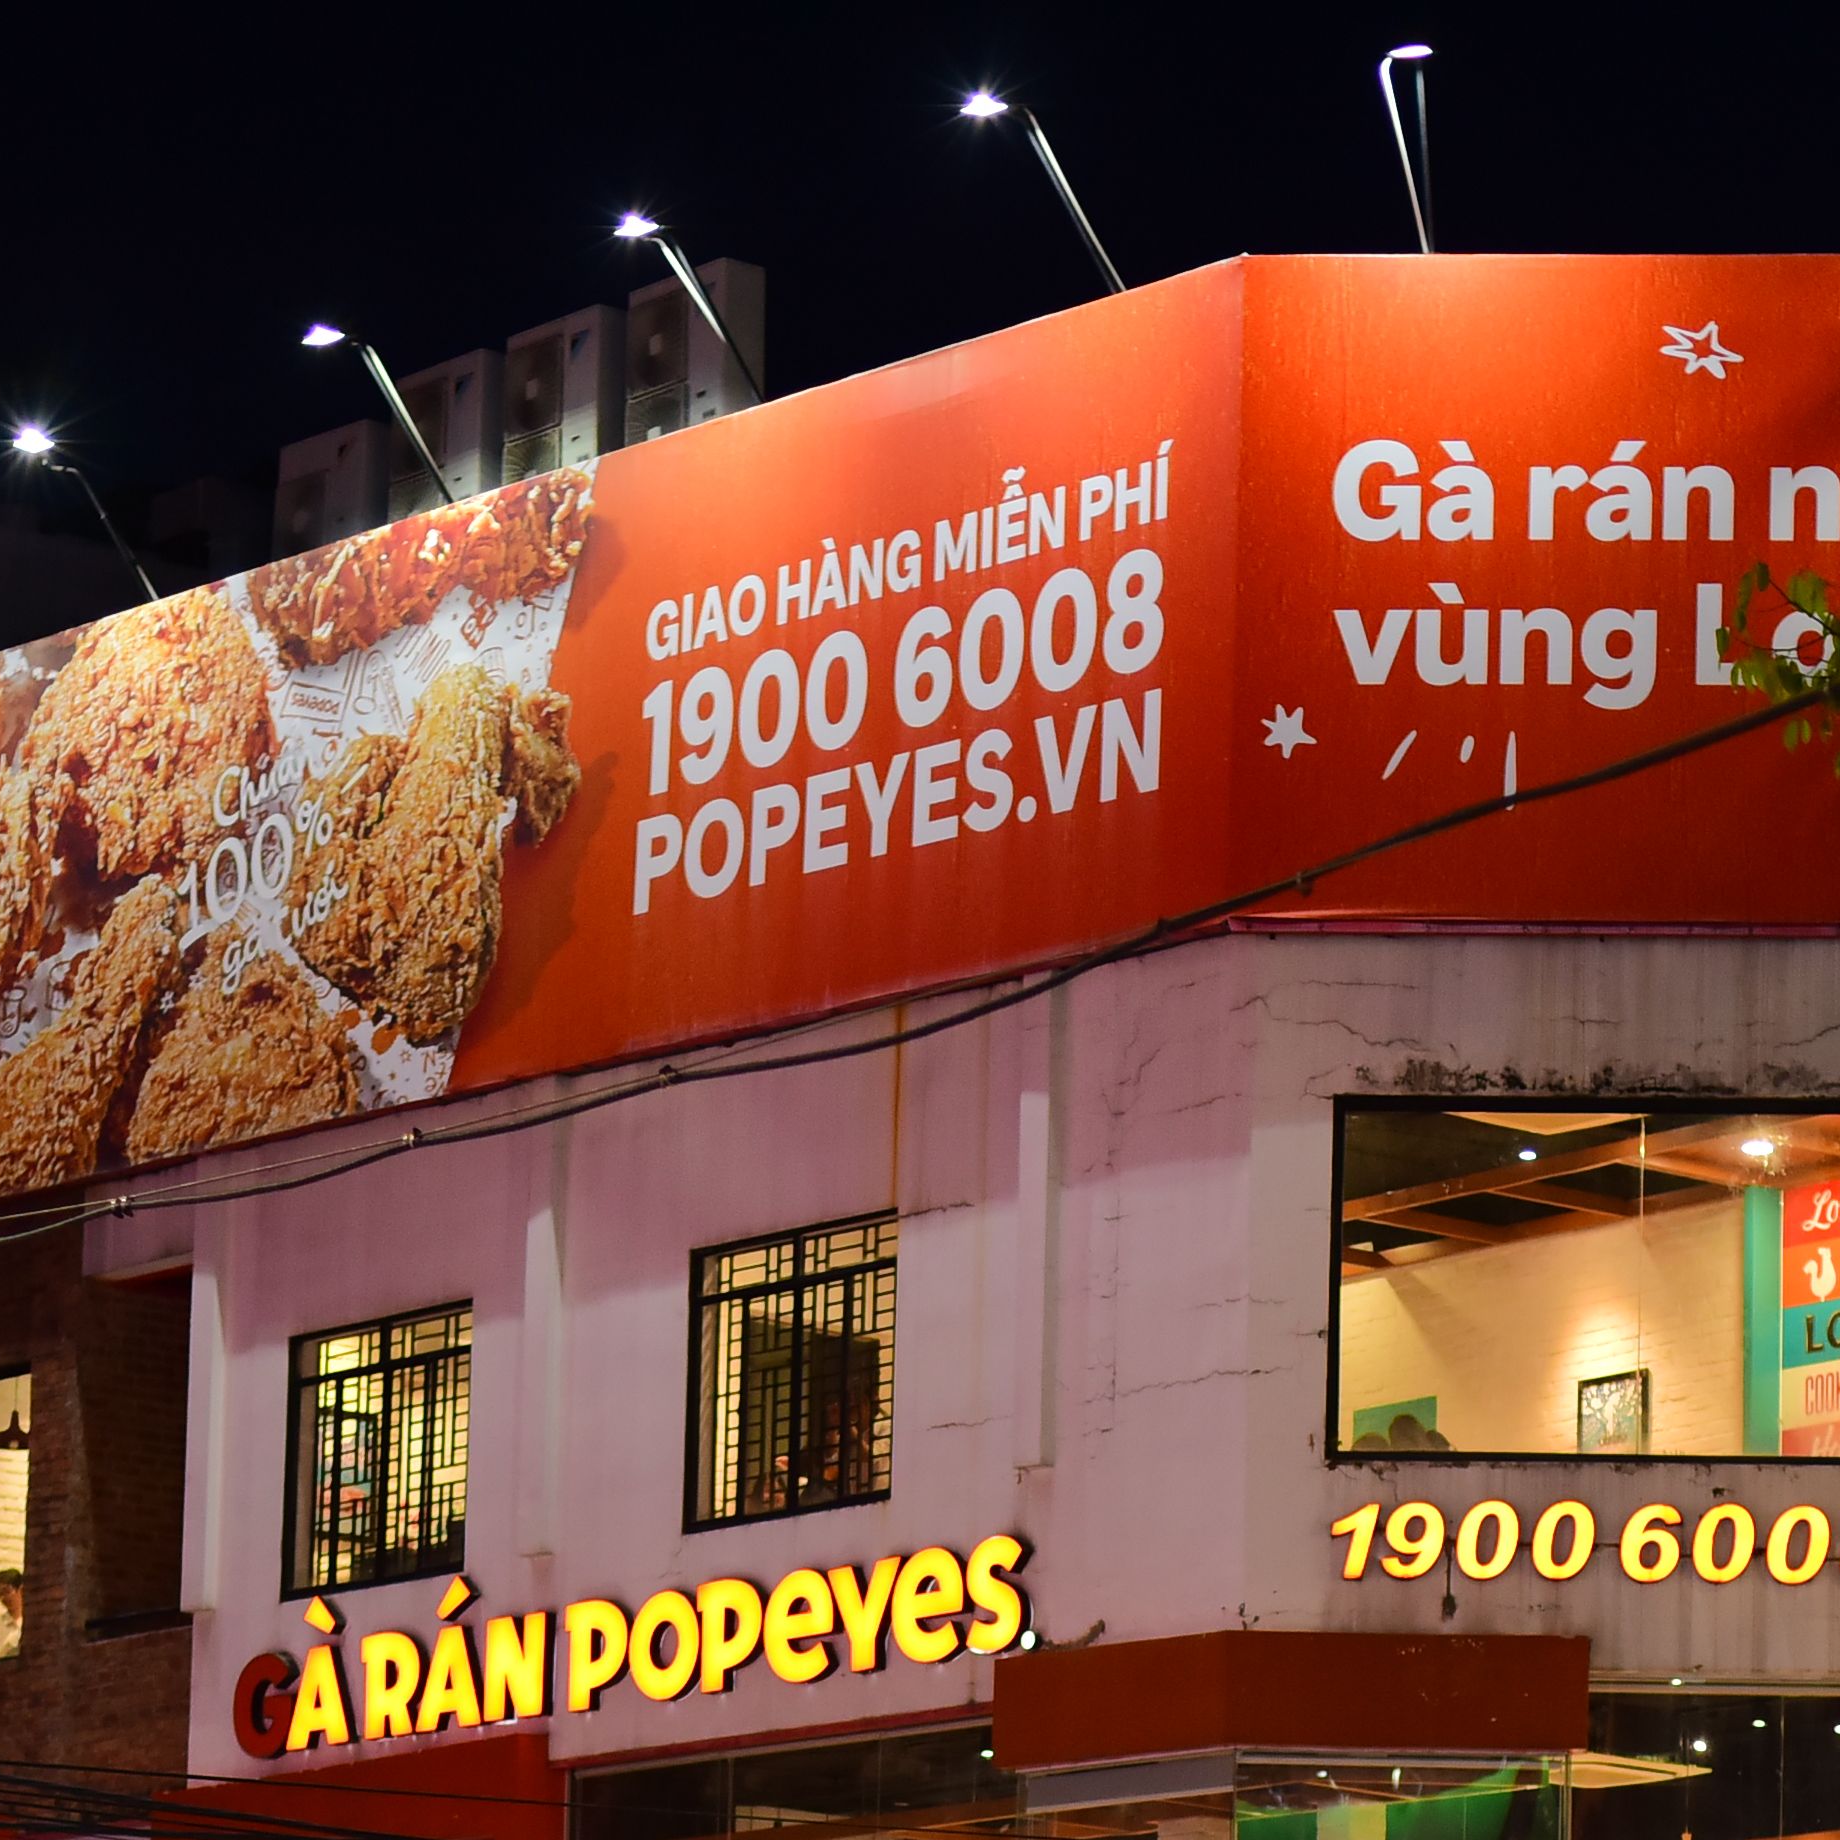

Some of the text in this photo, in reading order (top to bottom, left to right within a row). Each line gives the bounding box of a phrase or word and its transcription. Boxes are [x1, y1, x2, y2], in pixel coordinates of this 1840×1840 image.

[645, 438, 1174, 662] GIAO HÀNG MIỄN PHÍ
[1333, 437, 1494, 542] Gà
[1528, 437, 1748, 541] rán
[641, 547, 1164, 796] 1900 6008
[1333, 580, 1658, 711] vùng
[177, 792, 335, 953] 100%
[631, 687, 1164, 915] POPEYES.VN
[1330, 1499, 1598, 1582] 1900
[233, 1595, 355, 1760] GÀ
[361, 1574, 554, 1740] RÁN
